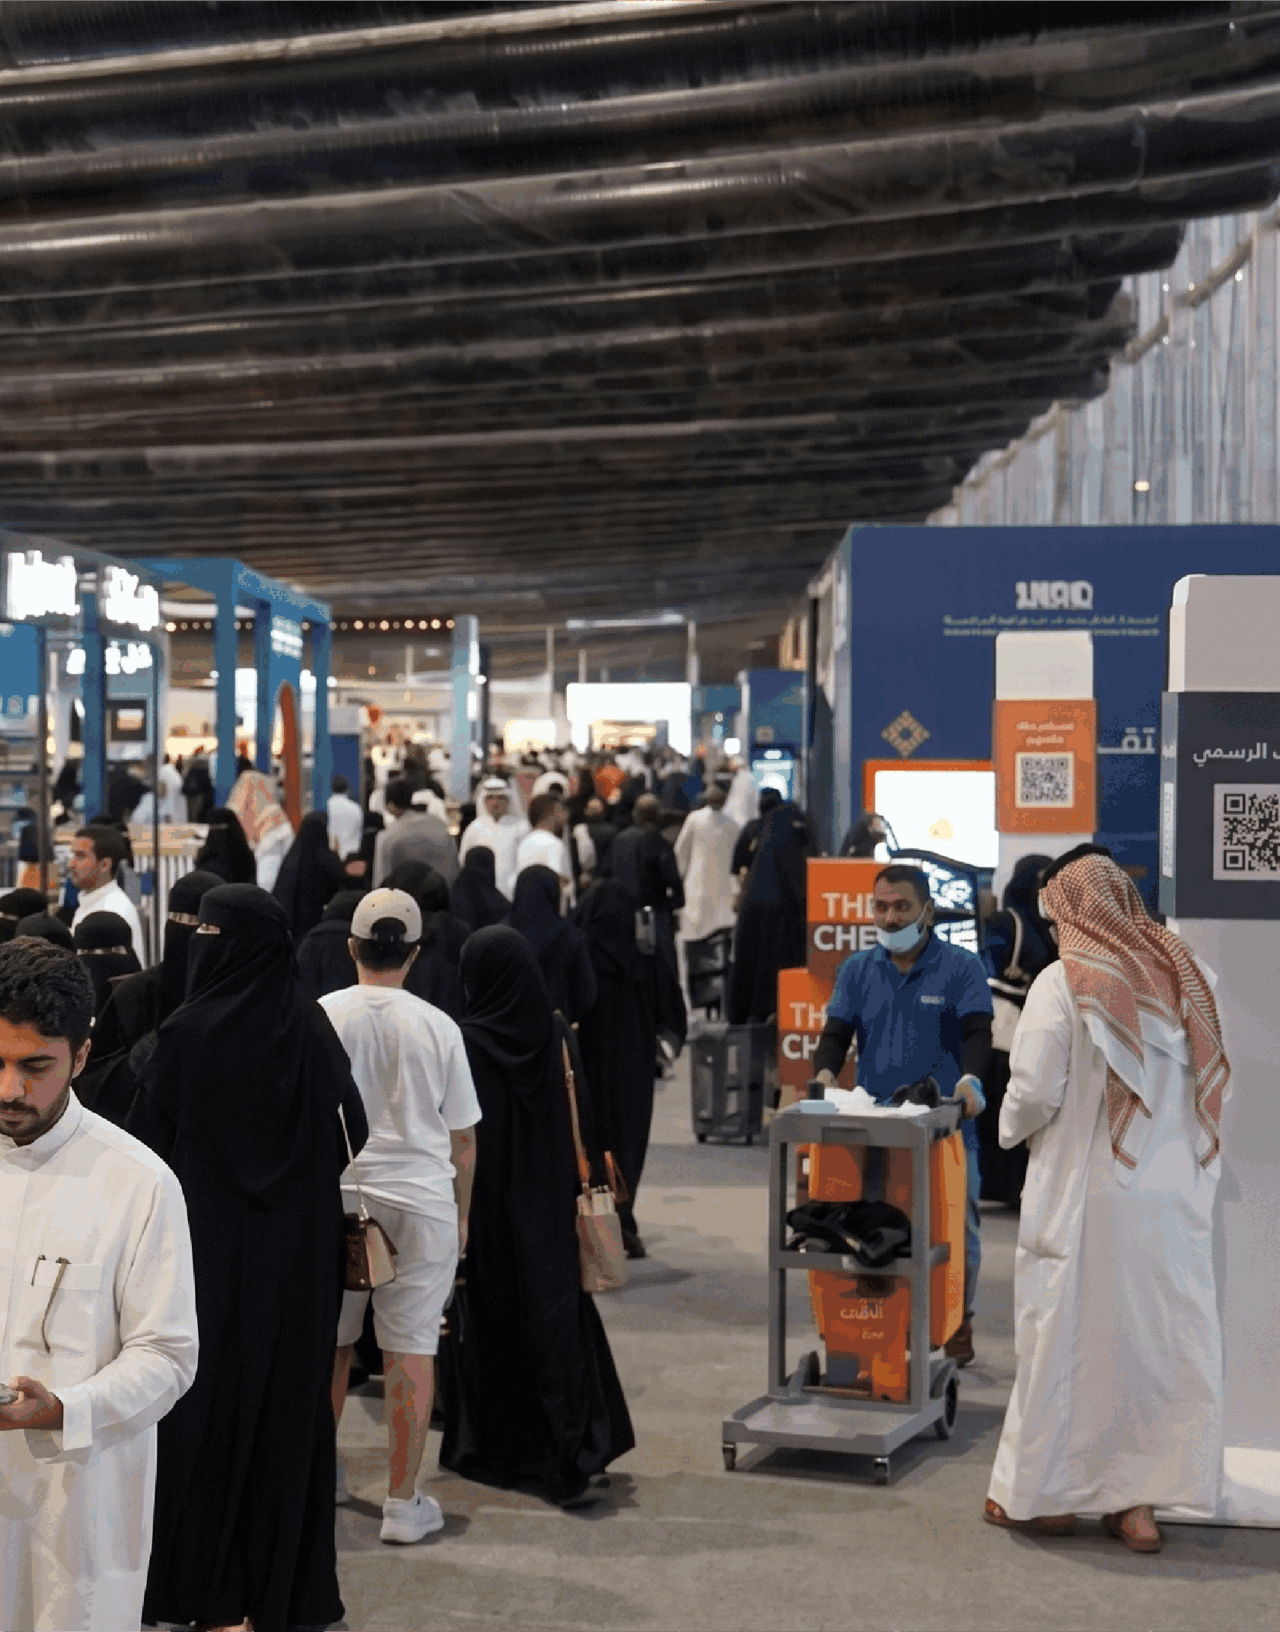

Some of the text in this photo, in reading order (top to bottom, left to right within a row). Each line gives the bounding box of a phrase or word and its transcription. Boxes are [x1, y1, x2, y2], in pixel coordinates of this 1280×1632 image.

[1193, 741, 1268, 768] الرسمي
[813, 924, 879, 951] CHE
[789, 1001, 829, 1030] TH
